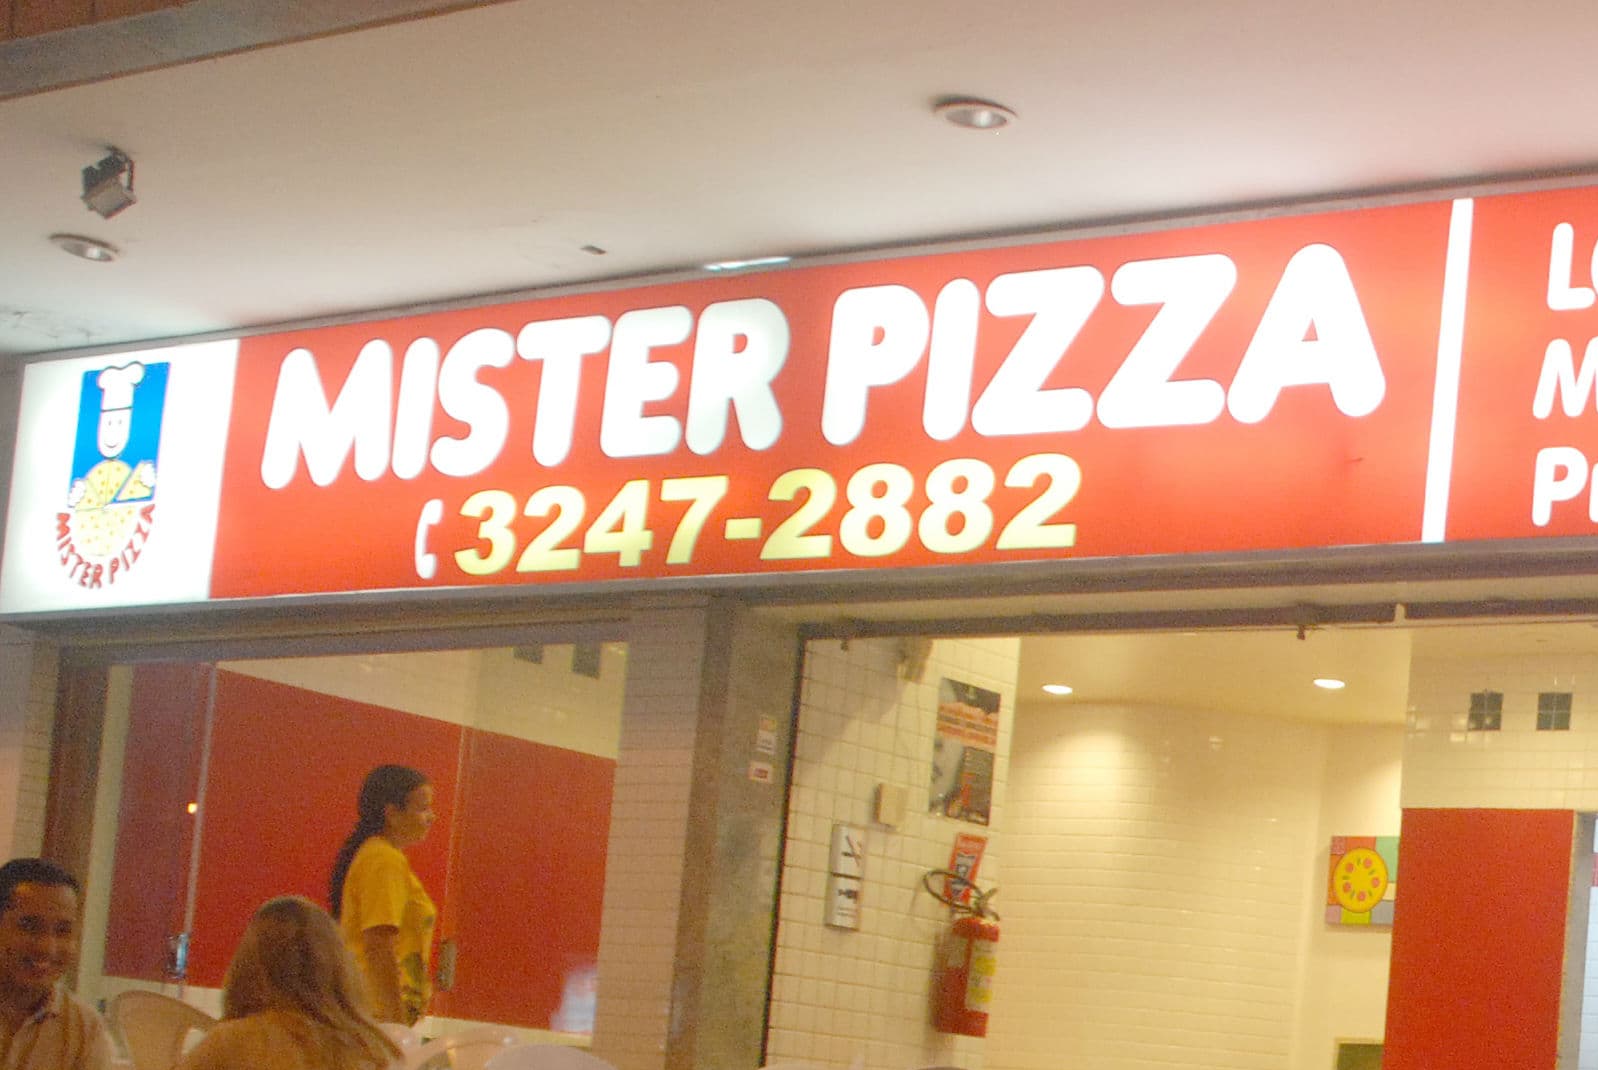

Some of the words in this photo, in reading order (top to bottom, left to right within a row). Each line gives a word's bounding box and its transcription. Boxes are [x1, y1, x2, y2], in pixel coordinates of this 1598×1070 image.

[261, 298, 790, 489] MISTER
[821, 243, 1387, 446] PIZZA
[56, 511, 104, 589] MISTER
[109, 503, 156, 585] PIZZA
[454, 452, 1083, 576] 3247-2882
